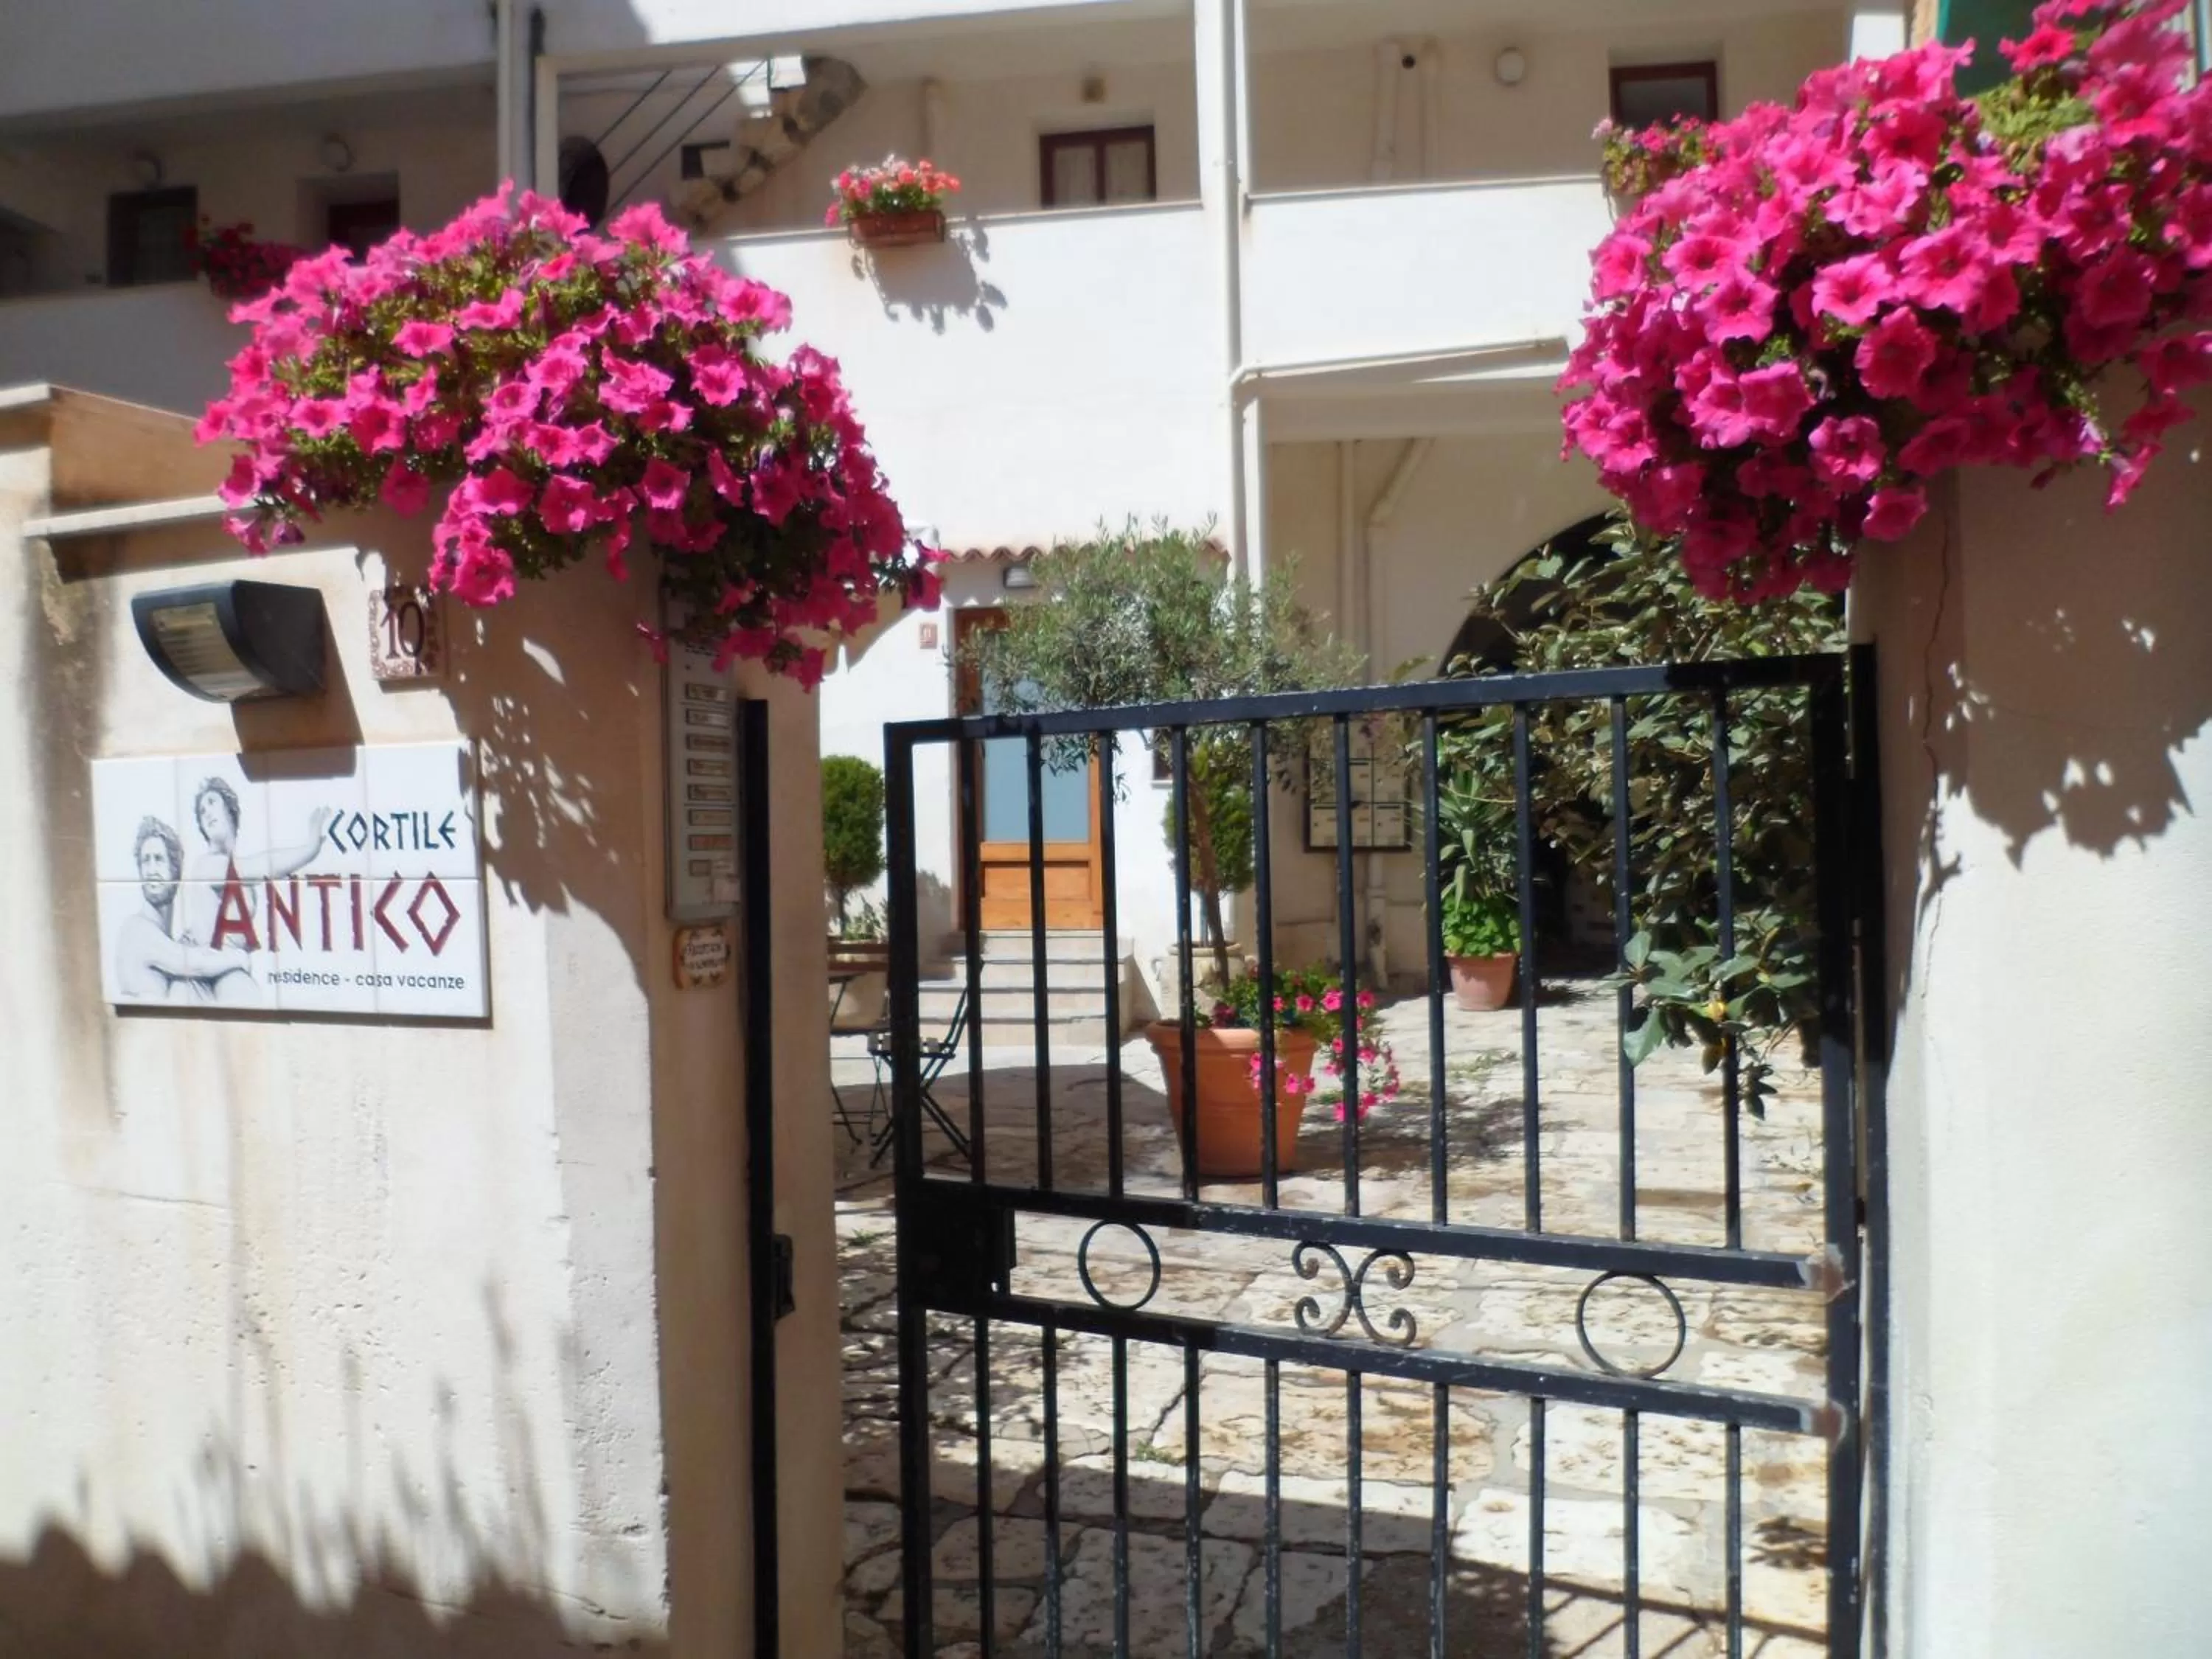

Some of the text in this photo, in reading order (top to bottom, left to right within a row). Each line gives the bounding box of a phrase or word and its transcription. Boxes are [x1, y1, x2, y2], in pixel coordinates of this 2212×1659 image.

[380, 601, 425, 659] 10
[328, 809, 456, 854] CORTILE
[210, 852, 461, 956] ANTICO
[268, 967, 341, 986] residence
[355, 973, 393, 987] casa
[397, 974, 465, 990] vacanze
